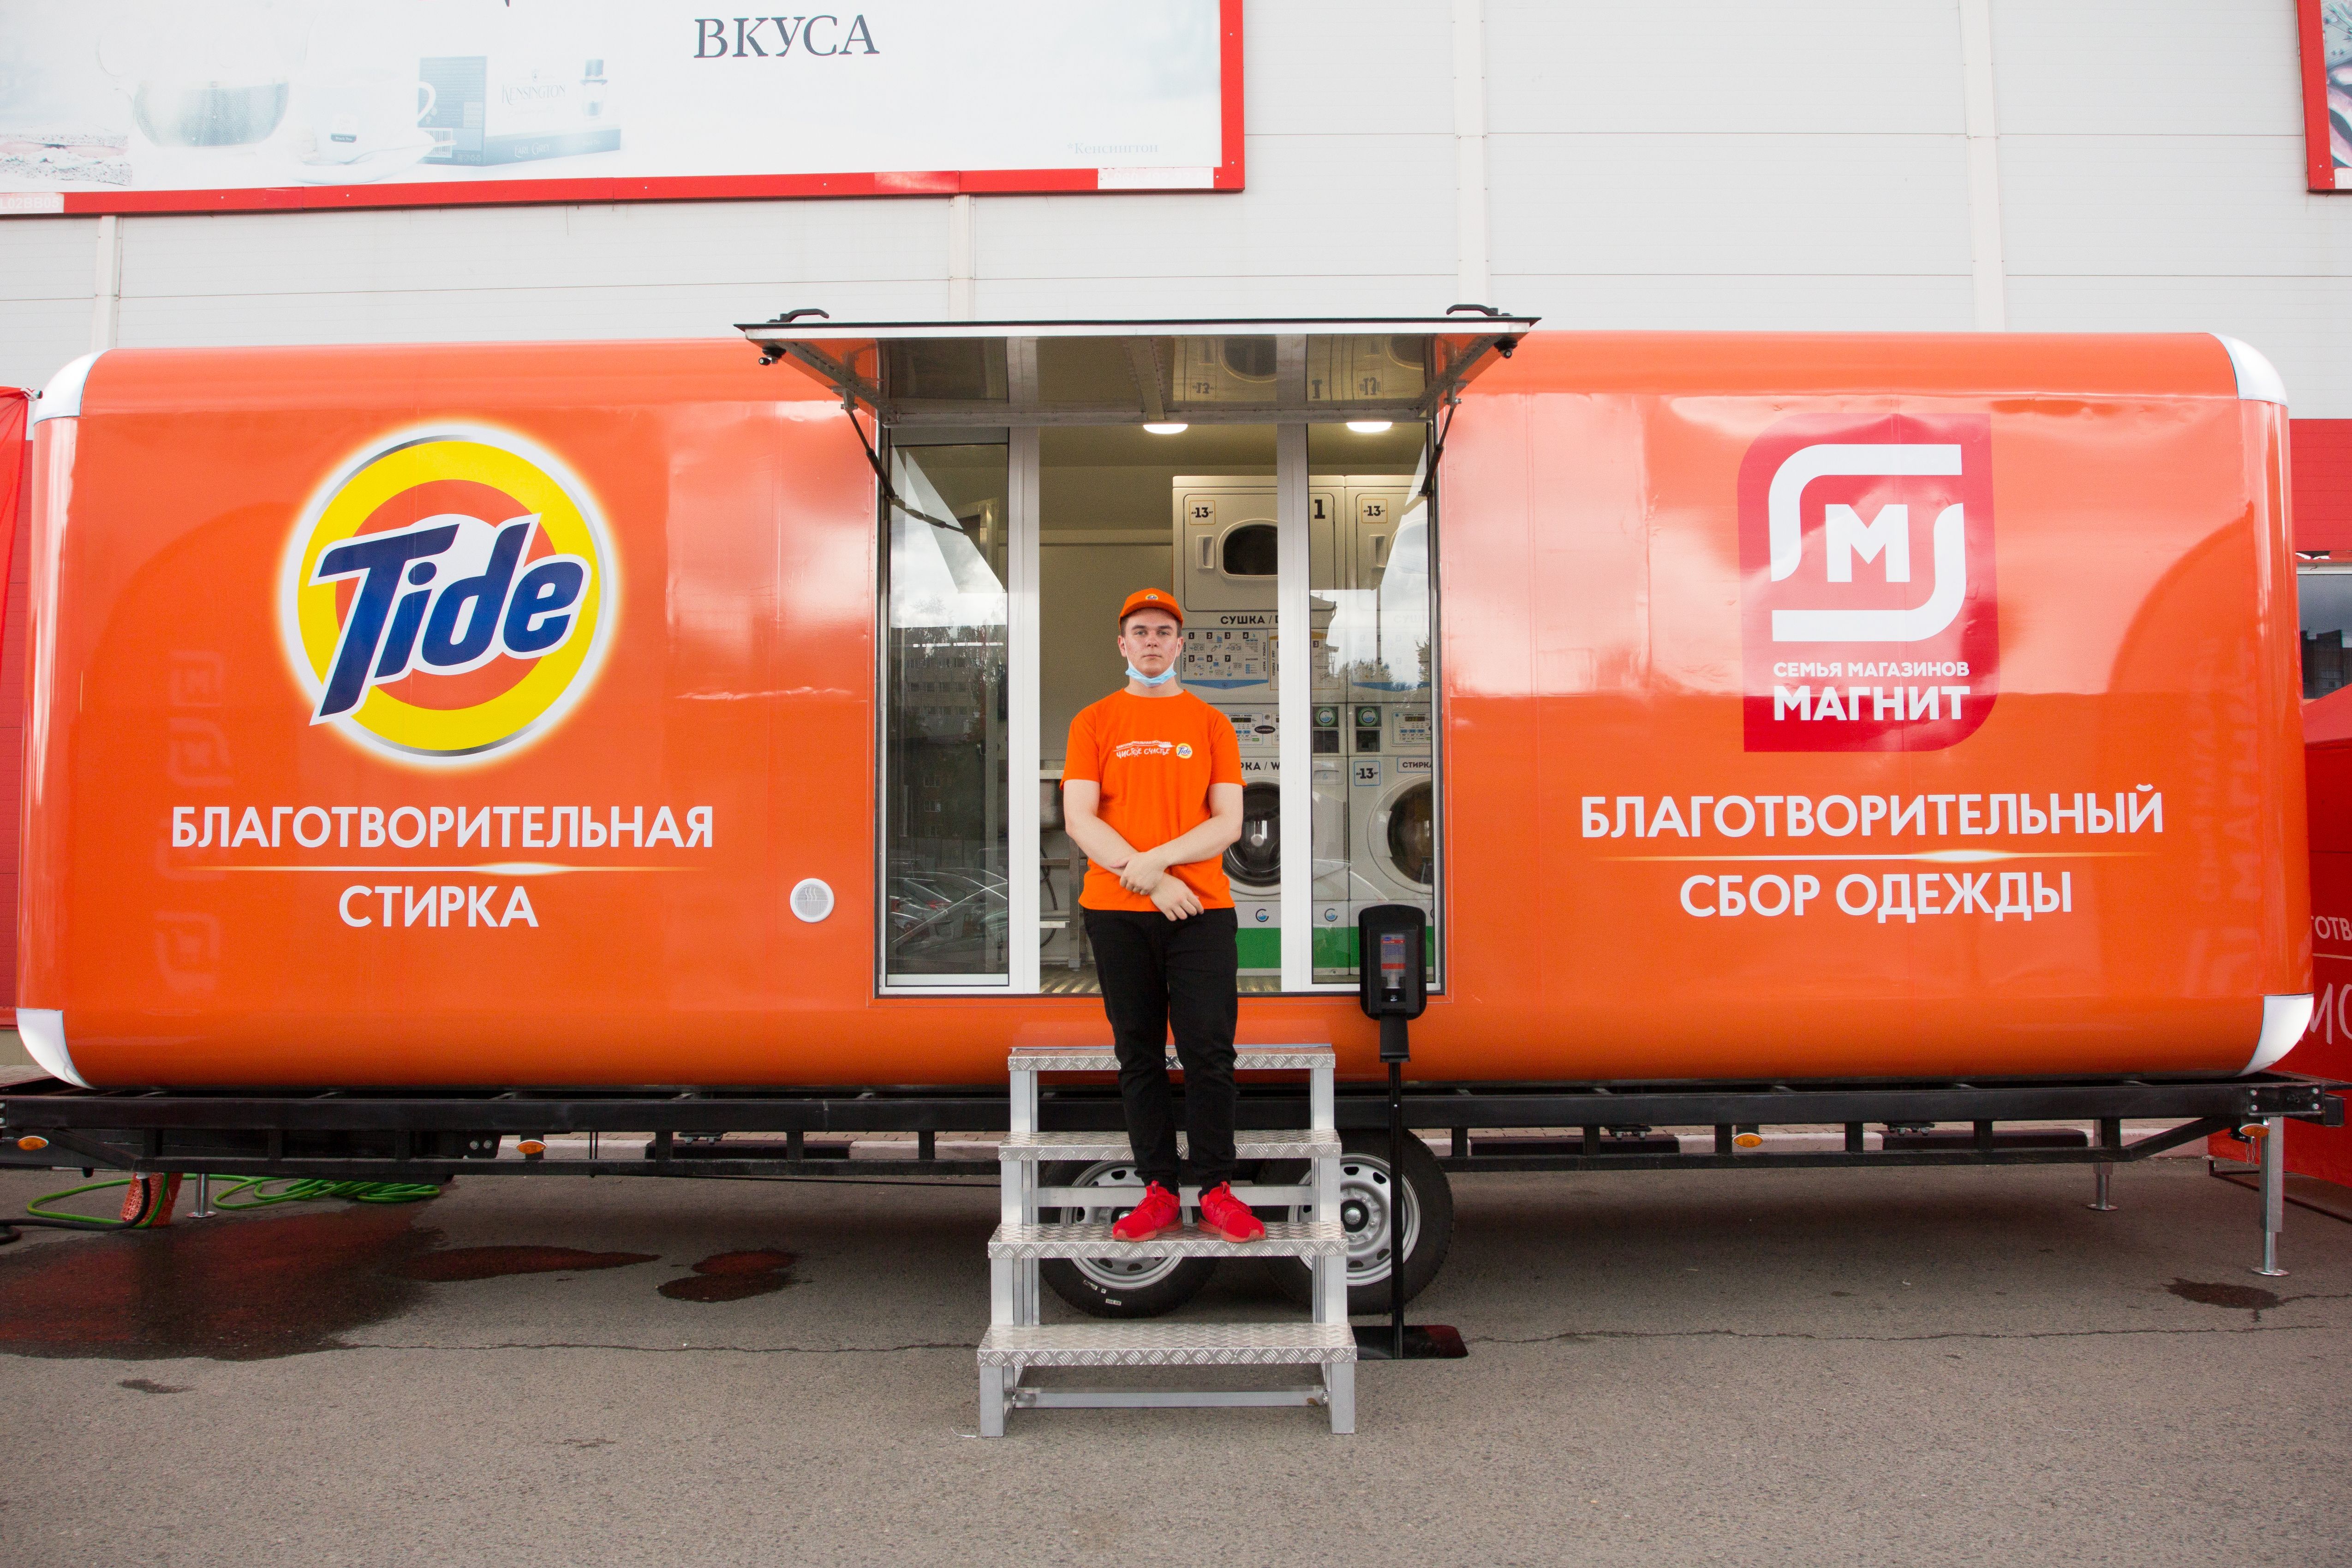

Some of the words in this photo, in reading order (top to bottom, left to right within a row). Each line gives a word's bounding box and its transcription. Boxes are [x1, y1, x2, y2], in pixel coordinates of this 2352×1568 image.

[694, 14, 880, 58] ВКУСА
[1195, 507, 1209, 518] 13
[1314, 499, 1325, 519] 1
[1367, 506, 1381, 516] 13
[317, 522, 584, 717] Tide
[1220, 615, 1265, 624] СУШКА
[1773, 662, 1842, 677] СЕМЬЯ
[1847, 662, 1970, 677] МАГАЗИНОВ
[1773, 685, 1971, 721] МАГНИТ
[1144, 748, 1170, 756] СЧАСТЬЕ
[1360, 768, 1374, 779] 13
[1582, 784, 2163, 838] БЛАГОТВОРИТЕЛЬНЫЙ
[172, 805, 713, 848] БЛАГОТВОРИТЕЛЬНАЯ
[339, 885, 539, 928] СТИРКА
[1681, 874, 1820, 917] СБОР
[1836, 871, 2071, 923] ОДЕЖДЫ
[2311, 916, 2352, 941] ОТВ
